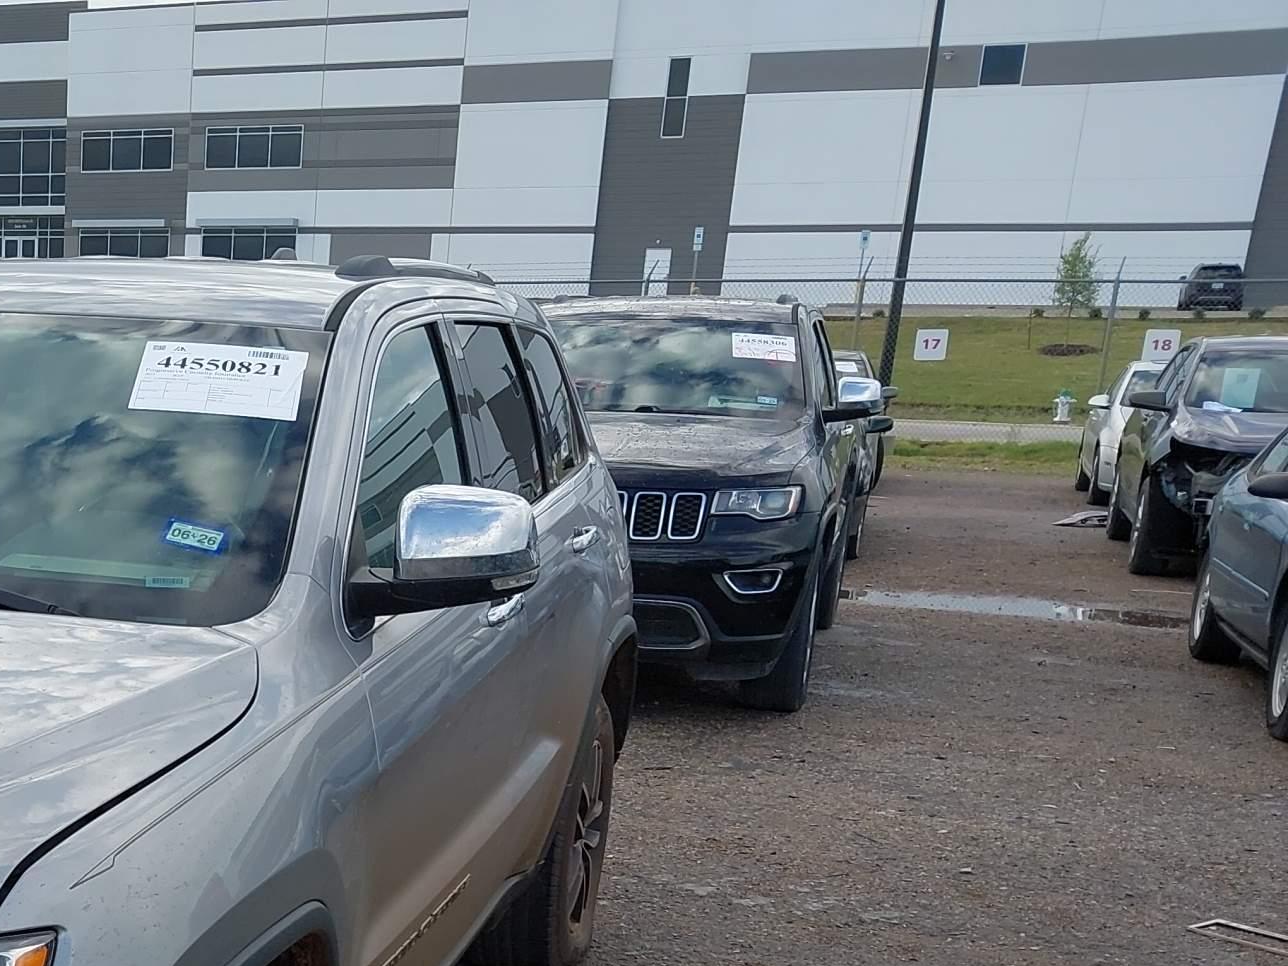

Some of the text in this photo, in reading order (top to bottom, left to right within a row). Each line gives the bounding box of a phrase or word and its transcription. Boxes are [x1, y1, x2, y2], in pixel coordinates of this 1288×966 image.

[921, 337, 941, 350] 17
[1151, 339, 1172, 351] 18
[156, 355, 282, 377] 44550821
